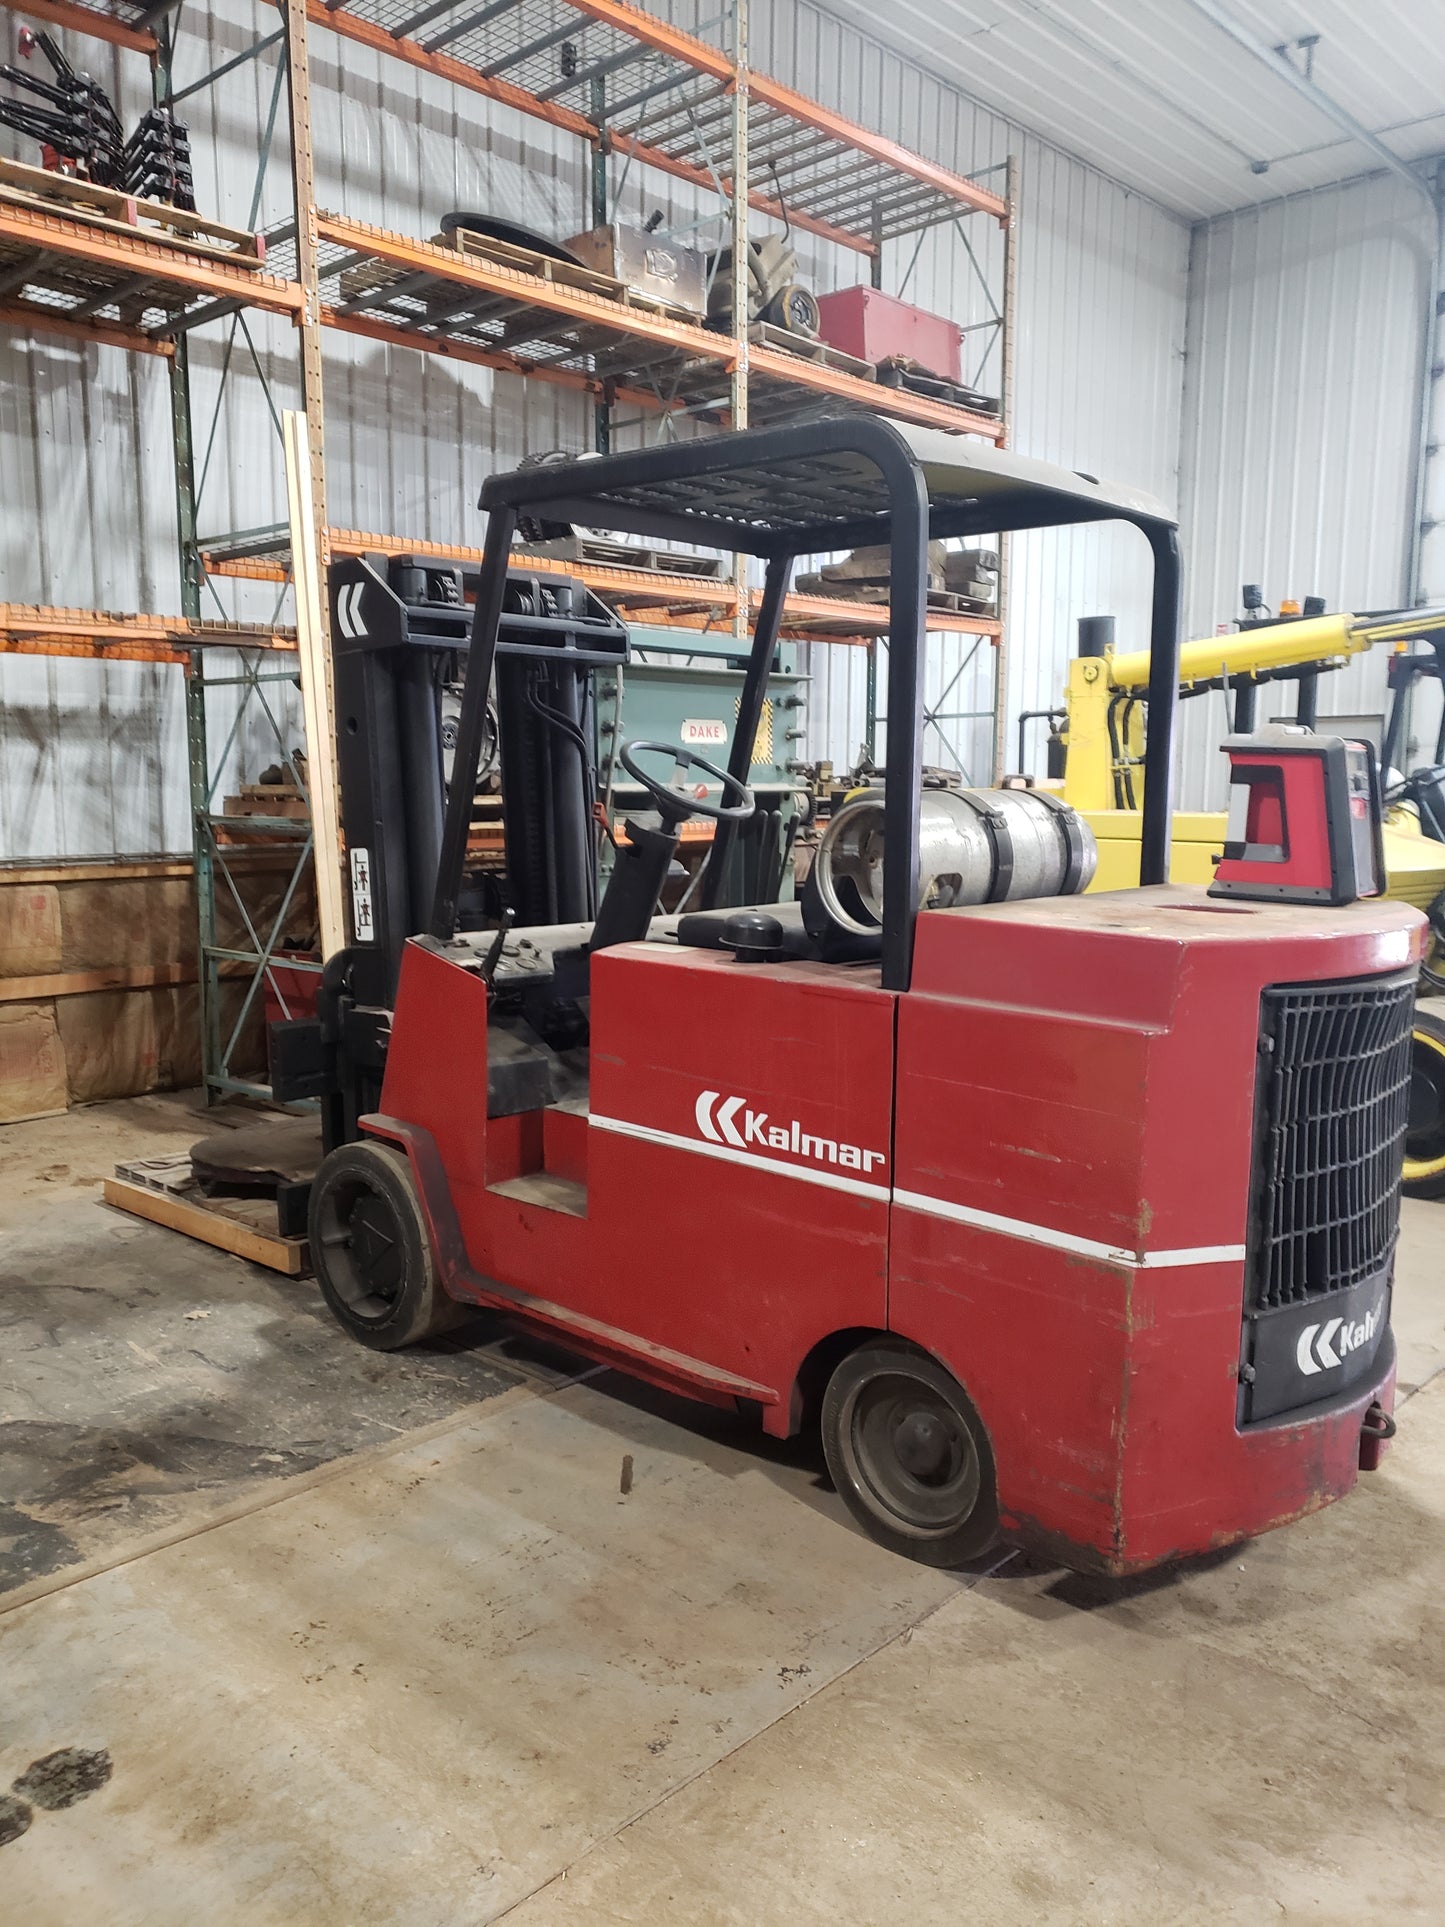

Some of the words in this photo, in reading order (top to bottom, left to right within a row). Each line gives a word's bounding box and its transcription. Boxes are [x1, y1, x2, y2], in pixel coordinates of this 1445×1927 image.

[689, 725, 720, 738] DAKE
[745, 1109, 886, 1173] Kalmar
[1340, 1294, 1384, 1357] Kal
